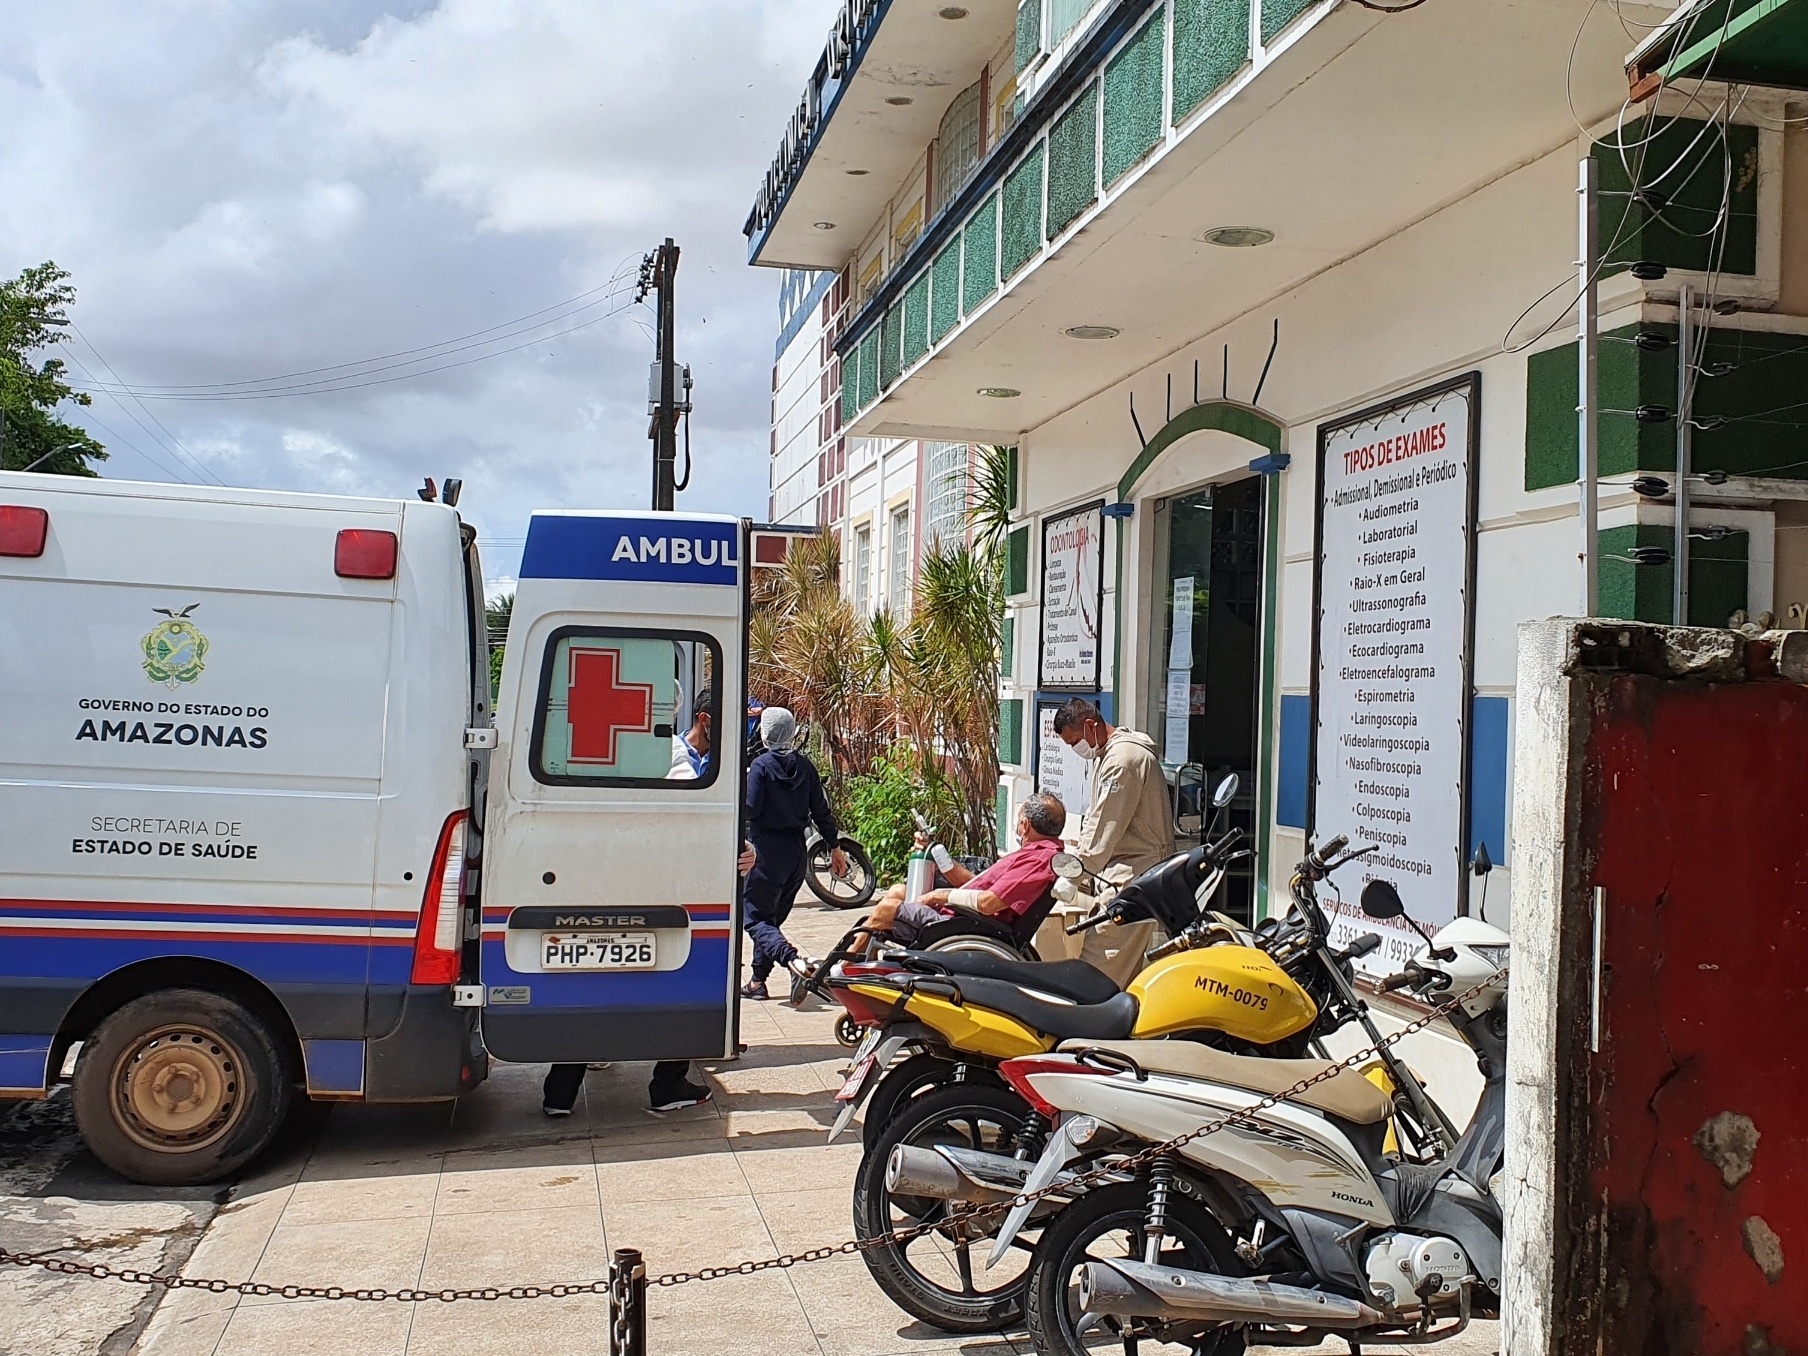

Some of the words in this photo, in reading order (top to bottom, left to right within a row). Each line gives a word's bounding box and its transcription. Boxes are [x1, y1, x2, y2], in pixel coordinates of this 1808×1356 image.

[1344, 444, 1375, 476] TIPOS
[1377, 438, 1393, 467] DE
[1395, 422, 1446, 463] EXAMES
[1334, 480, 1372, 508] Admissional,
[1373, 467, 1414, 498] Demissional
[1416, 474, 1420, 487] e
[1421, 460, 1457, 486] Periódico
[1363, 498, 1419, 521] Audiometria
[1050, 526, 1089, 554] ODONTOLOGIA
[1363, 521, 1417, 544] Laboratorial
[1364, 546, 1416, 567] Fisioterapia
[1354, 574, 1382, 590] Raio-X
[1384, 574, 1398, 587] em
[1400, 567, 1425, 584] Geral
[1352, 591, 1426, 613] Ultrassonografia
[1348, 616, 1431, 636] Eletrocardiograma
[1352, 641, 1424, 658] Ecocardiograma
[1343, 664, 1435, 682] Eletroencefalograma
[1358, 689, 1415, 705] Espirometria
[79, 699, 154, 712] GOVERNO
[158, 703, 180, 713] DO
[185, 704, 243, 716] ESTADO
[247, 707, 269, 717] DO
[1354, 711, 1418, 729] Laringoscopia
[76, 719, 268, 748] AMAZONAS
[1343, 733, 1430, 753] Videolaringoscopia
[1349, 756, 1422, 777] Nasofibroscopia
[1358, 780, 1410, 799] Endoscopia
[1356, 802, 1411, 823] Colposcopia
[91, 816, 209, 836] SECRETARIA
[215, 821, 242, 836] DE
[1359, 826, 1407, 847] Peniscopia
[72, 838, 152, 855] ESTADO
[158, 842, 185, 856] DE
[191, 839, 258, 859] SAÚDE
[555, 916, 646, 926] MASTER
[1352, 905, 1362, 920] DE
[1194, 975, 1268, 1011] MTM-0079
[1331, 1191, 1374, 1208] HONDA
